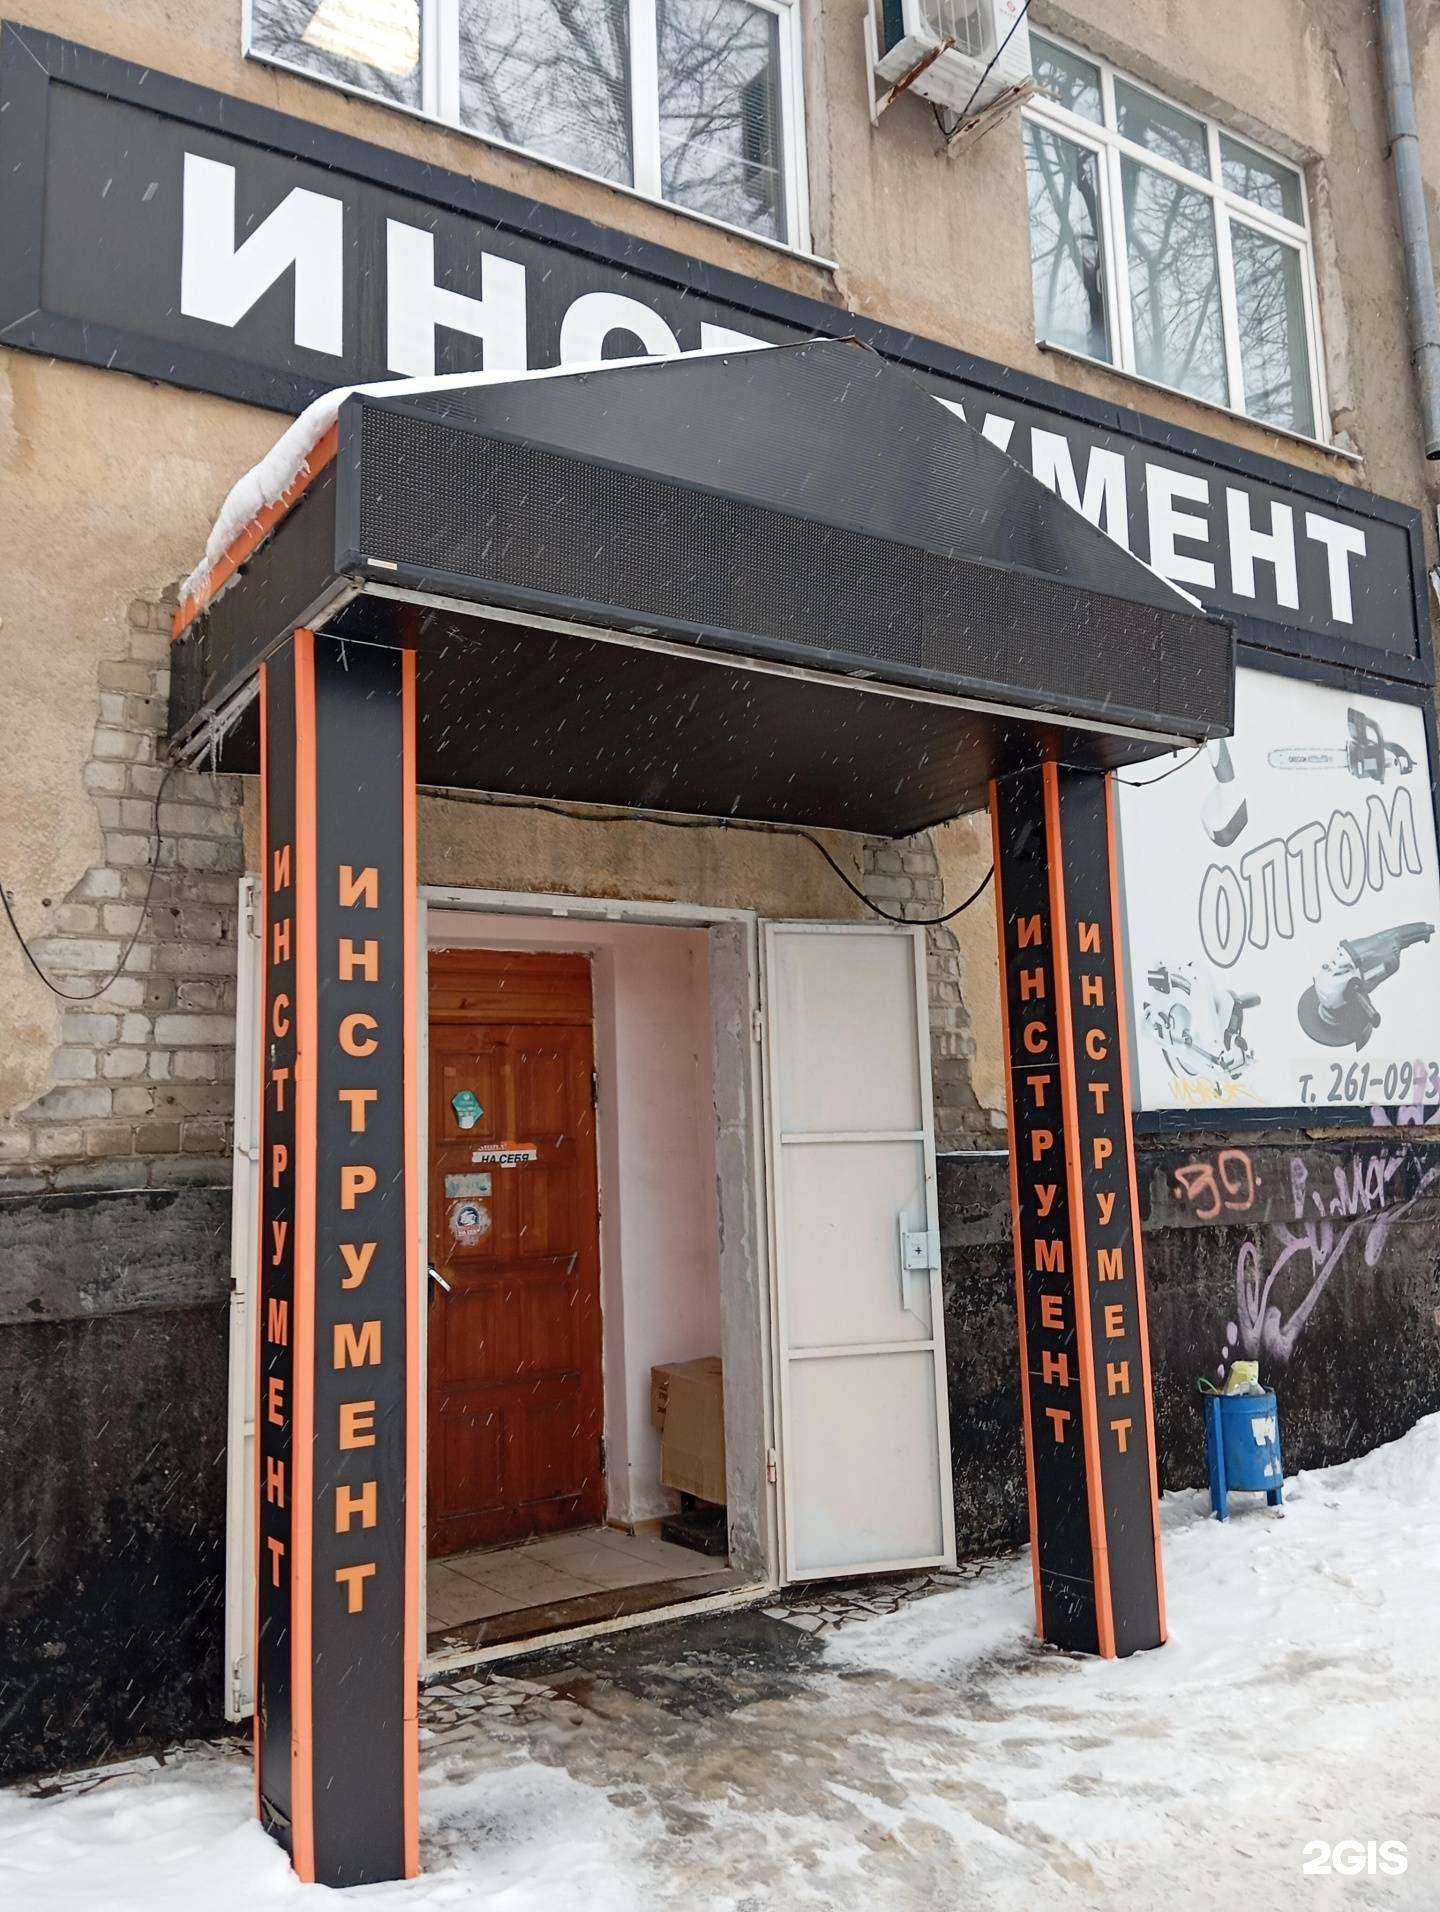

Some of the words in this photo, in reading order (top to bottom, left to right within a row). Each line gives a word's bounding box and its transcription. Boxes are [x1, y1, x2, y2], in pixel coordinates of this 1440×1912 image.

[180, 151, 1368, 625] ИНМЕНТ
[1198, 786, 1422, 969] ОПТОМ
[267, 844, 290, 1588] ИНСТРУМЕНТ
[333, 865, 382, 1614] ИНСТРУМЕНТ
[1018, 915, 1071, 1443] ИНСТРУМЕНТ
[1078, 921, 1132, 1453] ИНСТРУМЕНТ
